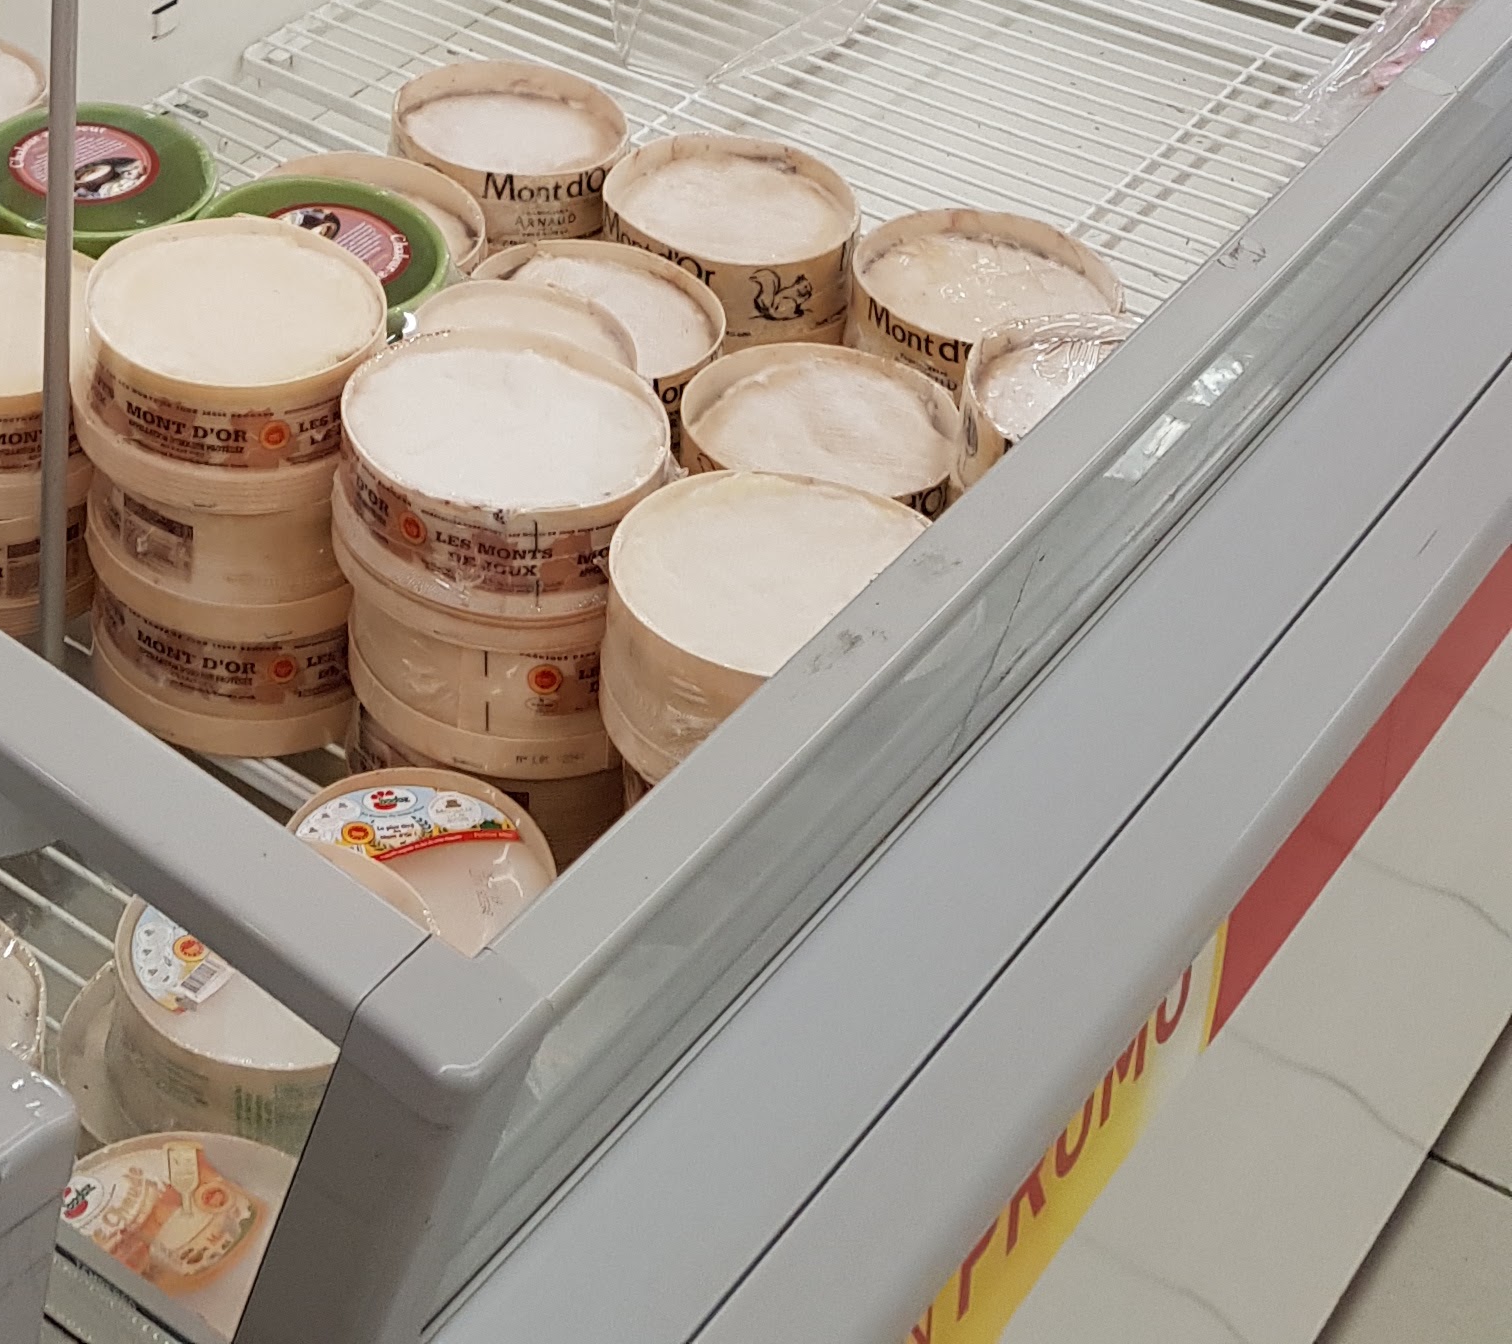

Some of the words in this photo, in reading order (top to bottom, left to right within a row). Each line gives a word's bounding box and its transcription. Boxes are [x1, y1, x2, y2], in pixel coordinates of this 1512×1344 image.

[482, 172, 563, 202] Mont
[515, 214, 576, 228] ARNAUD
[868, 297, 934, 356] Mont
[126, 401, 186, 435] MONT
[193, 425, 247, 443] D'OR
[435, 530, 472, 549] LES
[477, 541, 553, 560] MONTS
[138, 630, 197, 665] MONT
[203, 657, 256, 674] D'OR
